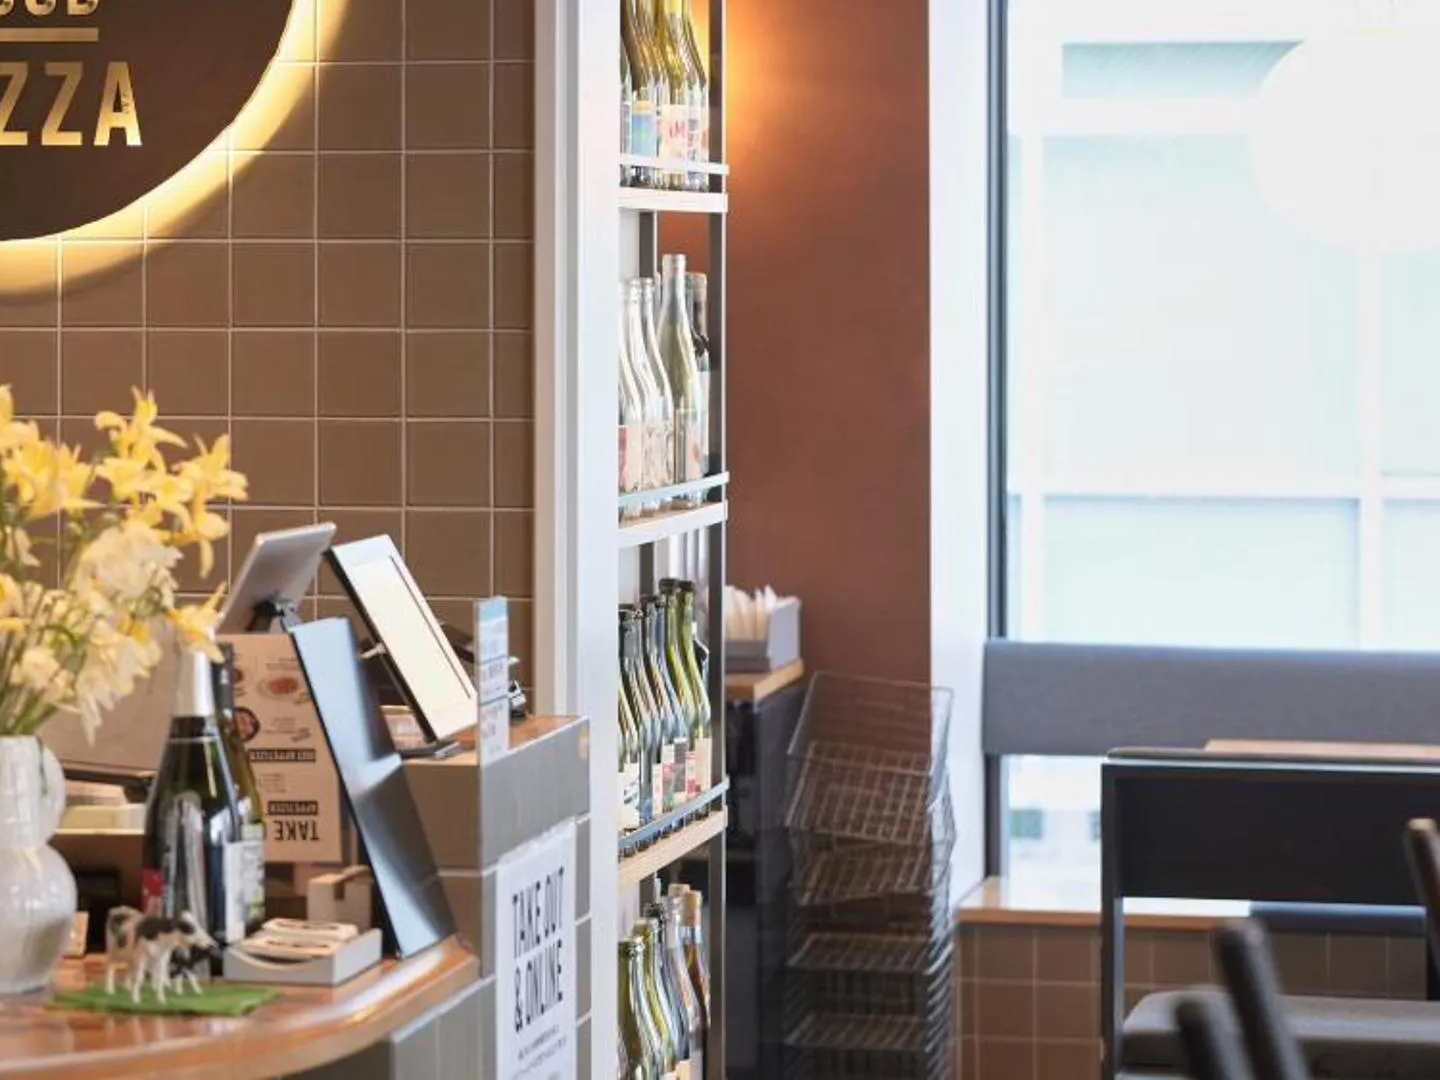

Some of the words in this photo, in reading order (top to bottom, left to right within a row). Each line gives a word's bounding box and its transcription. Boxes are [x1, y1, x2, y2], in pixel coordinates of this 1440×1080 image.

[274, 820, 320, 841] TAKE
[512, 880, 541, 959] TAKE
[544, 866, 564, 938] OUT
[513, 966, 523, 1033] &
[525, 938, 563, 1025] ONLINE
